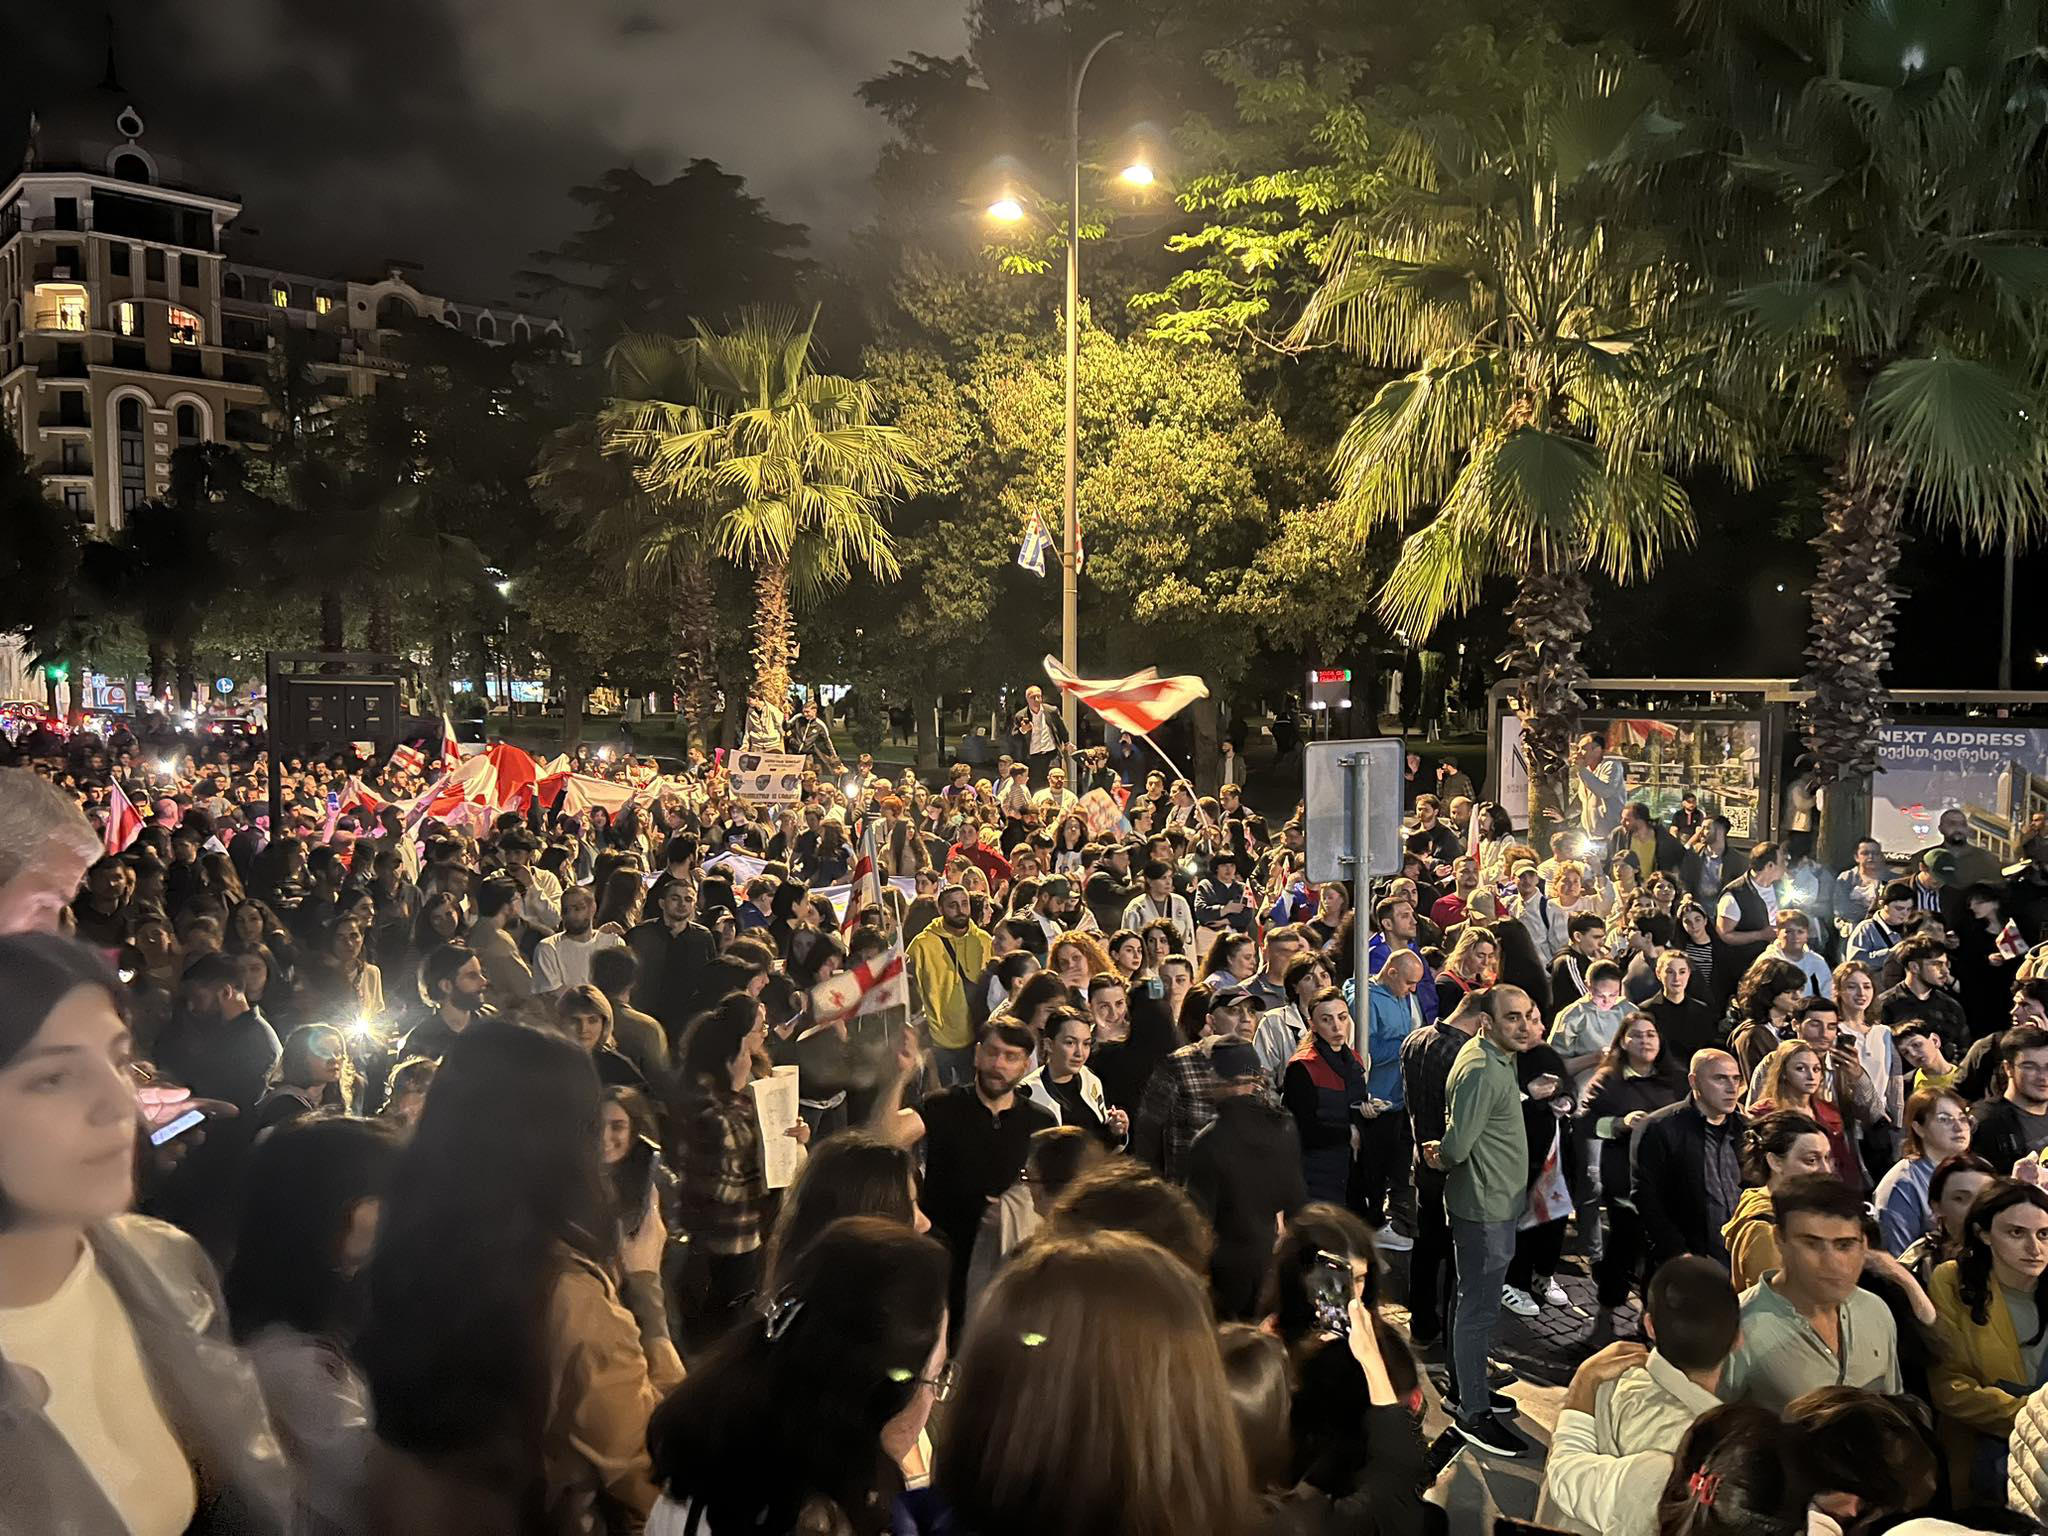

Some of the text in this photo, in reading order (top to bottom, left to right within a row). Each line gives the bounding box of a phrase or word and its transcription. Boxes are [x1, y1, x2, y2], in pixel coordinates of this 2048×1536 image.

[1878, 731, 2026, 747] NEXT ADDRESS
[1933, 747, 1999, 761] ედრესი
